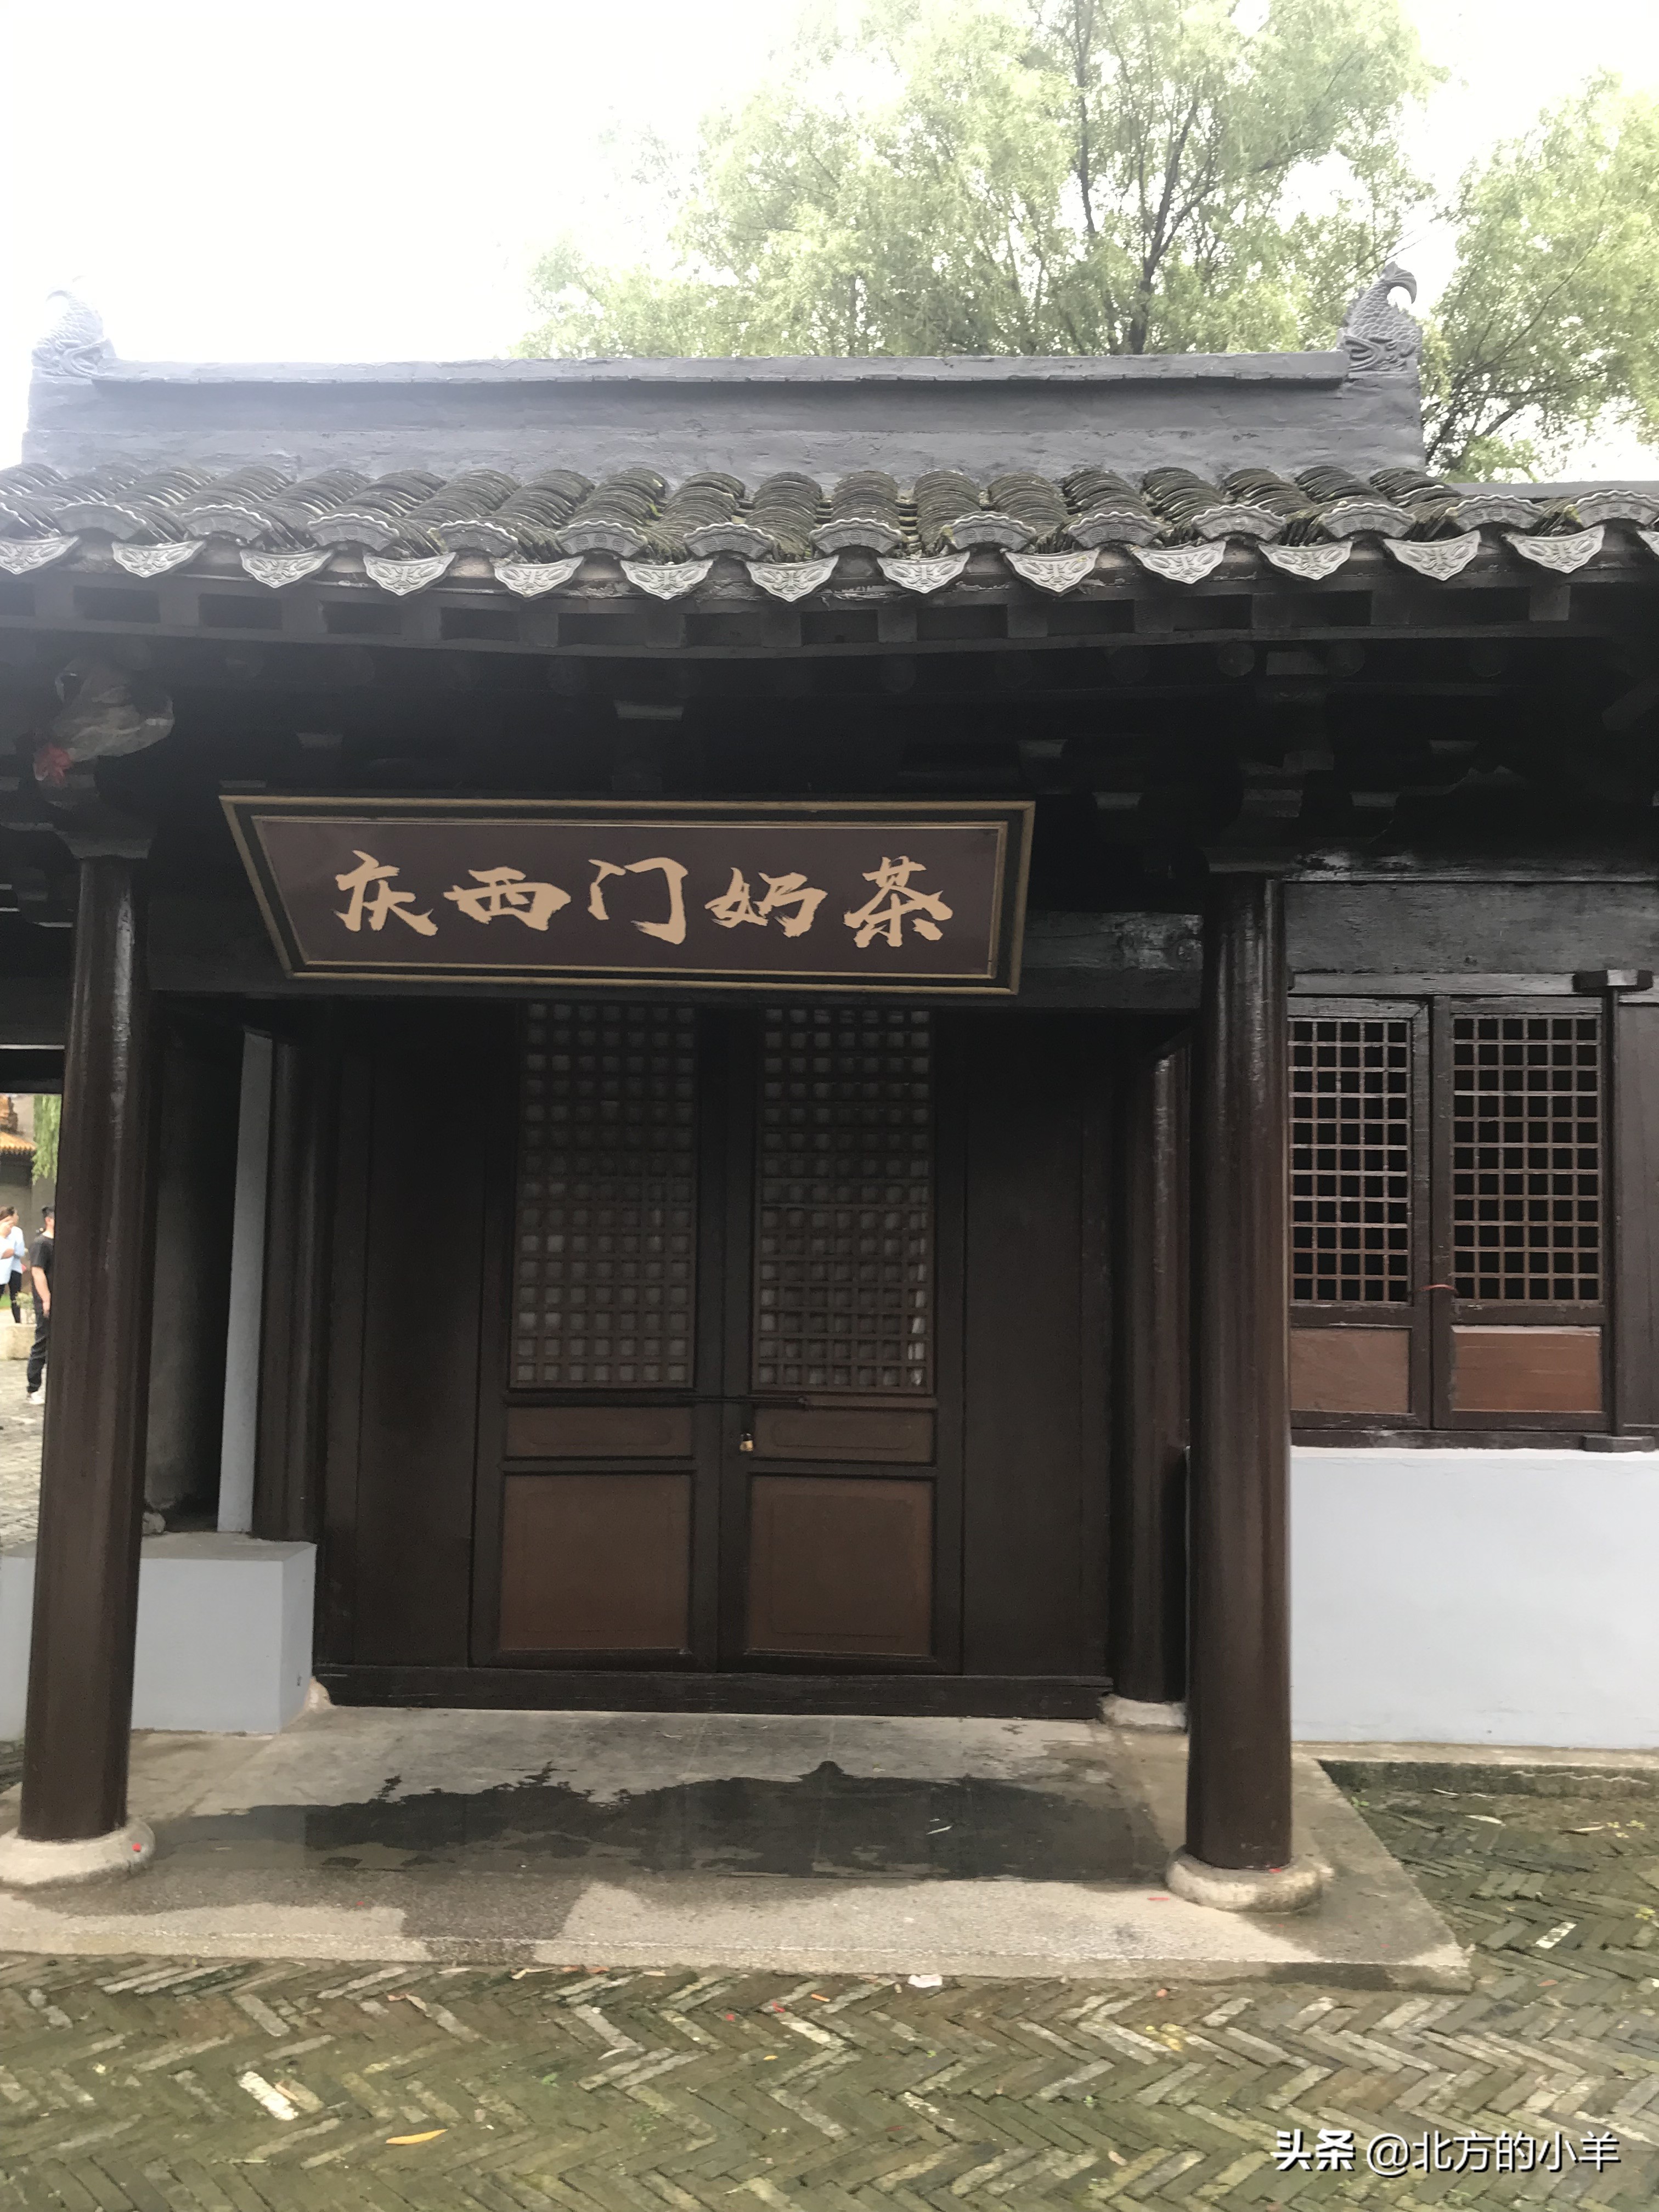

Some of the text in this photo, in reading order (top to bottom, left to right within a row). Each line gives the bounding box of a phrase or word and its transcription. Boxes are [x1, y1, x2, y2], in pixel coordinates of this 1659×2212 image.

[335, 850, 953, 949] 庆西门奶茶
